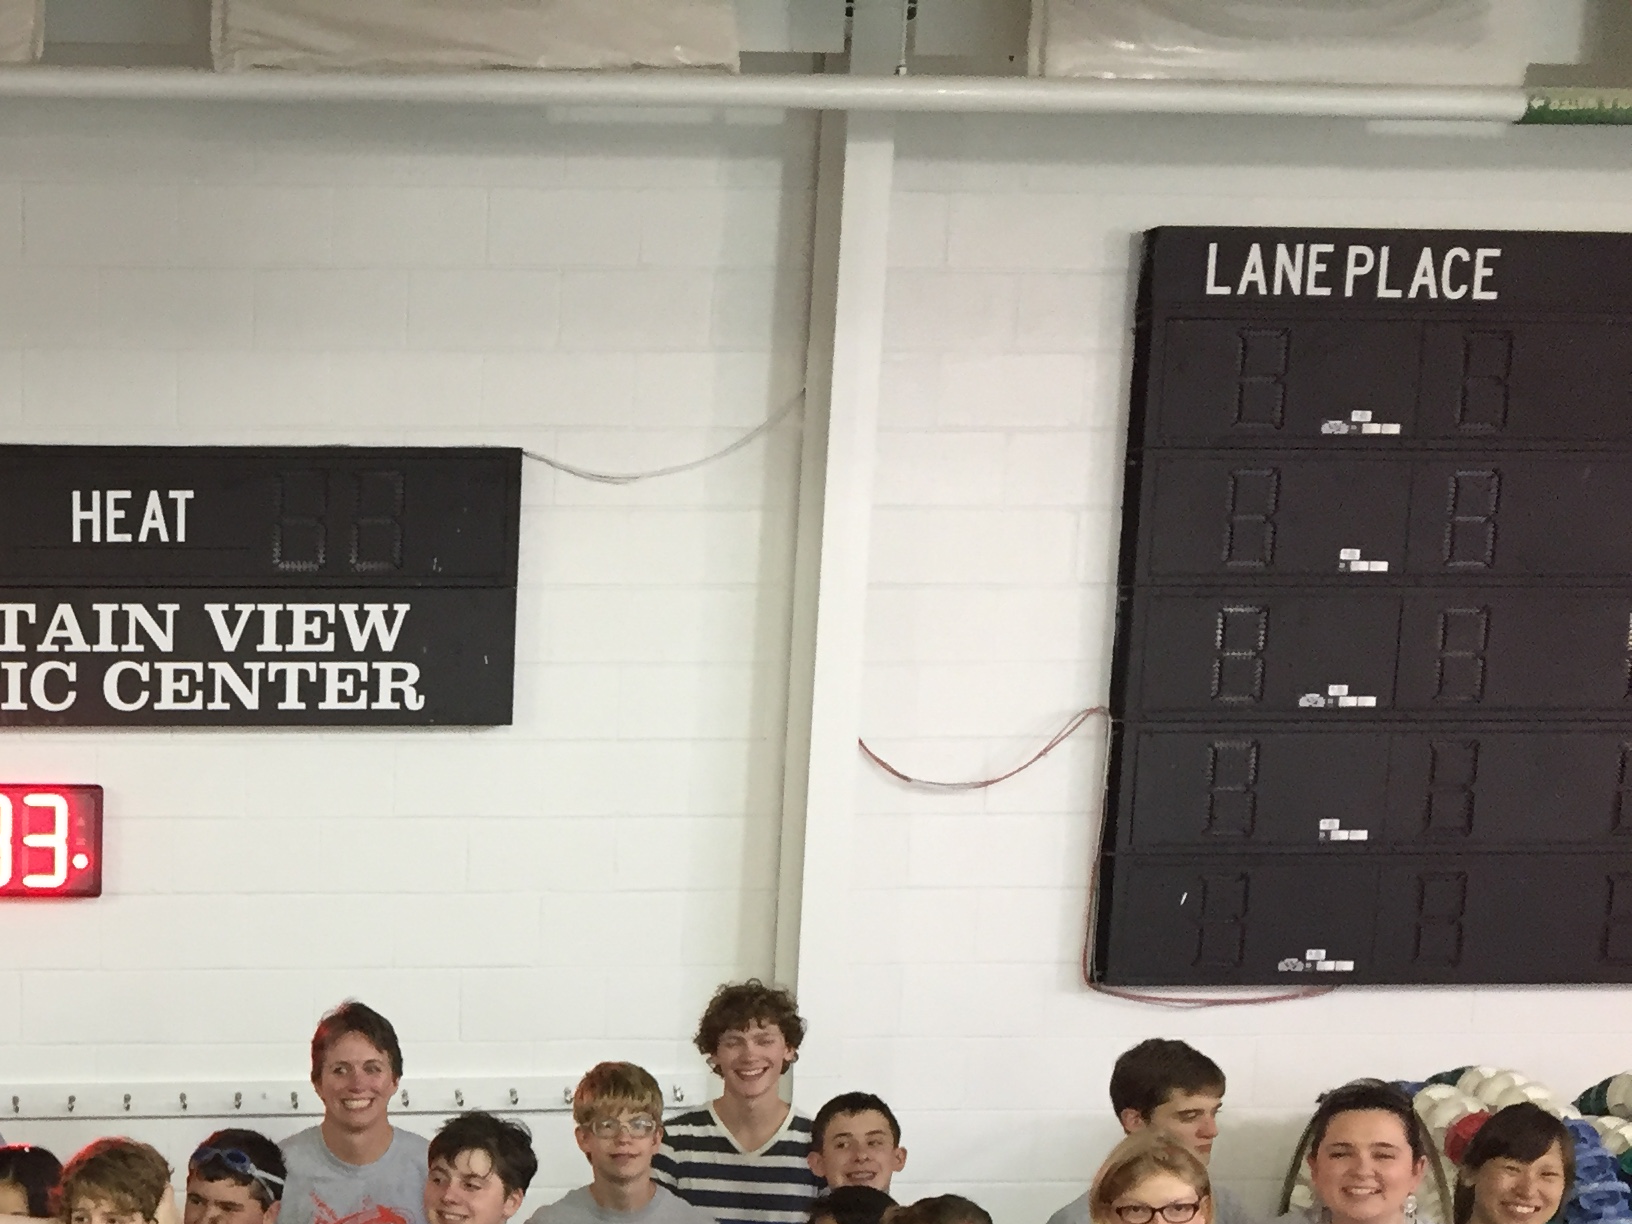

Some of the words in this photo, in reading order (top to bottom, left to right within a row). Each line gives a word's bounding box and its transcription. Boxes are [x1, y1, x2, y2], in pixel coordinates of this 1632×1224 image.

[1205, 242, 1335, 296] LANE
[1344, 245, 1502, 301] PLACE
[71, 489, 195, 543] HEAT
[203, 602, 411, 653] VIEW
[102, 660, 426, 712] CENTER
